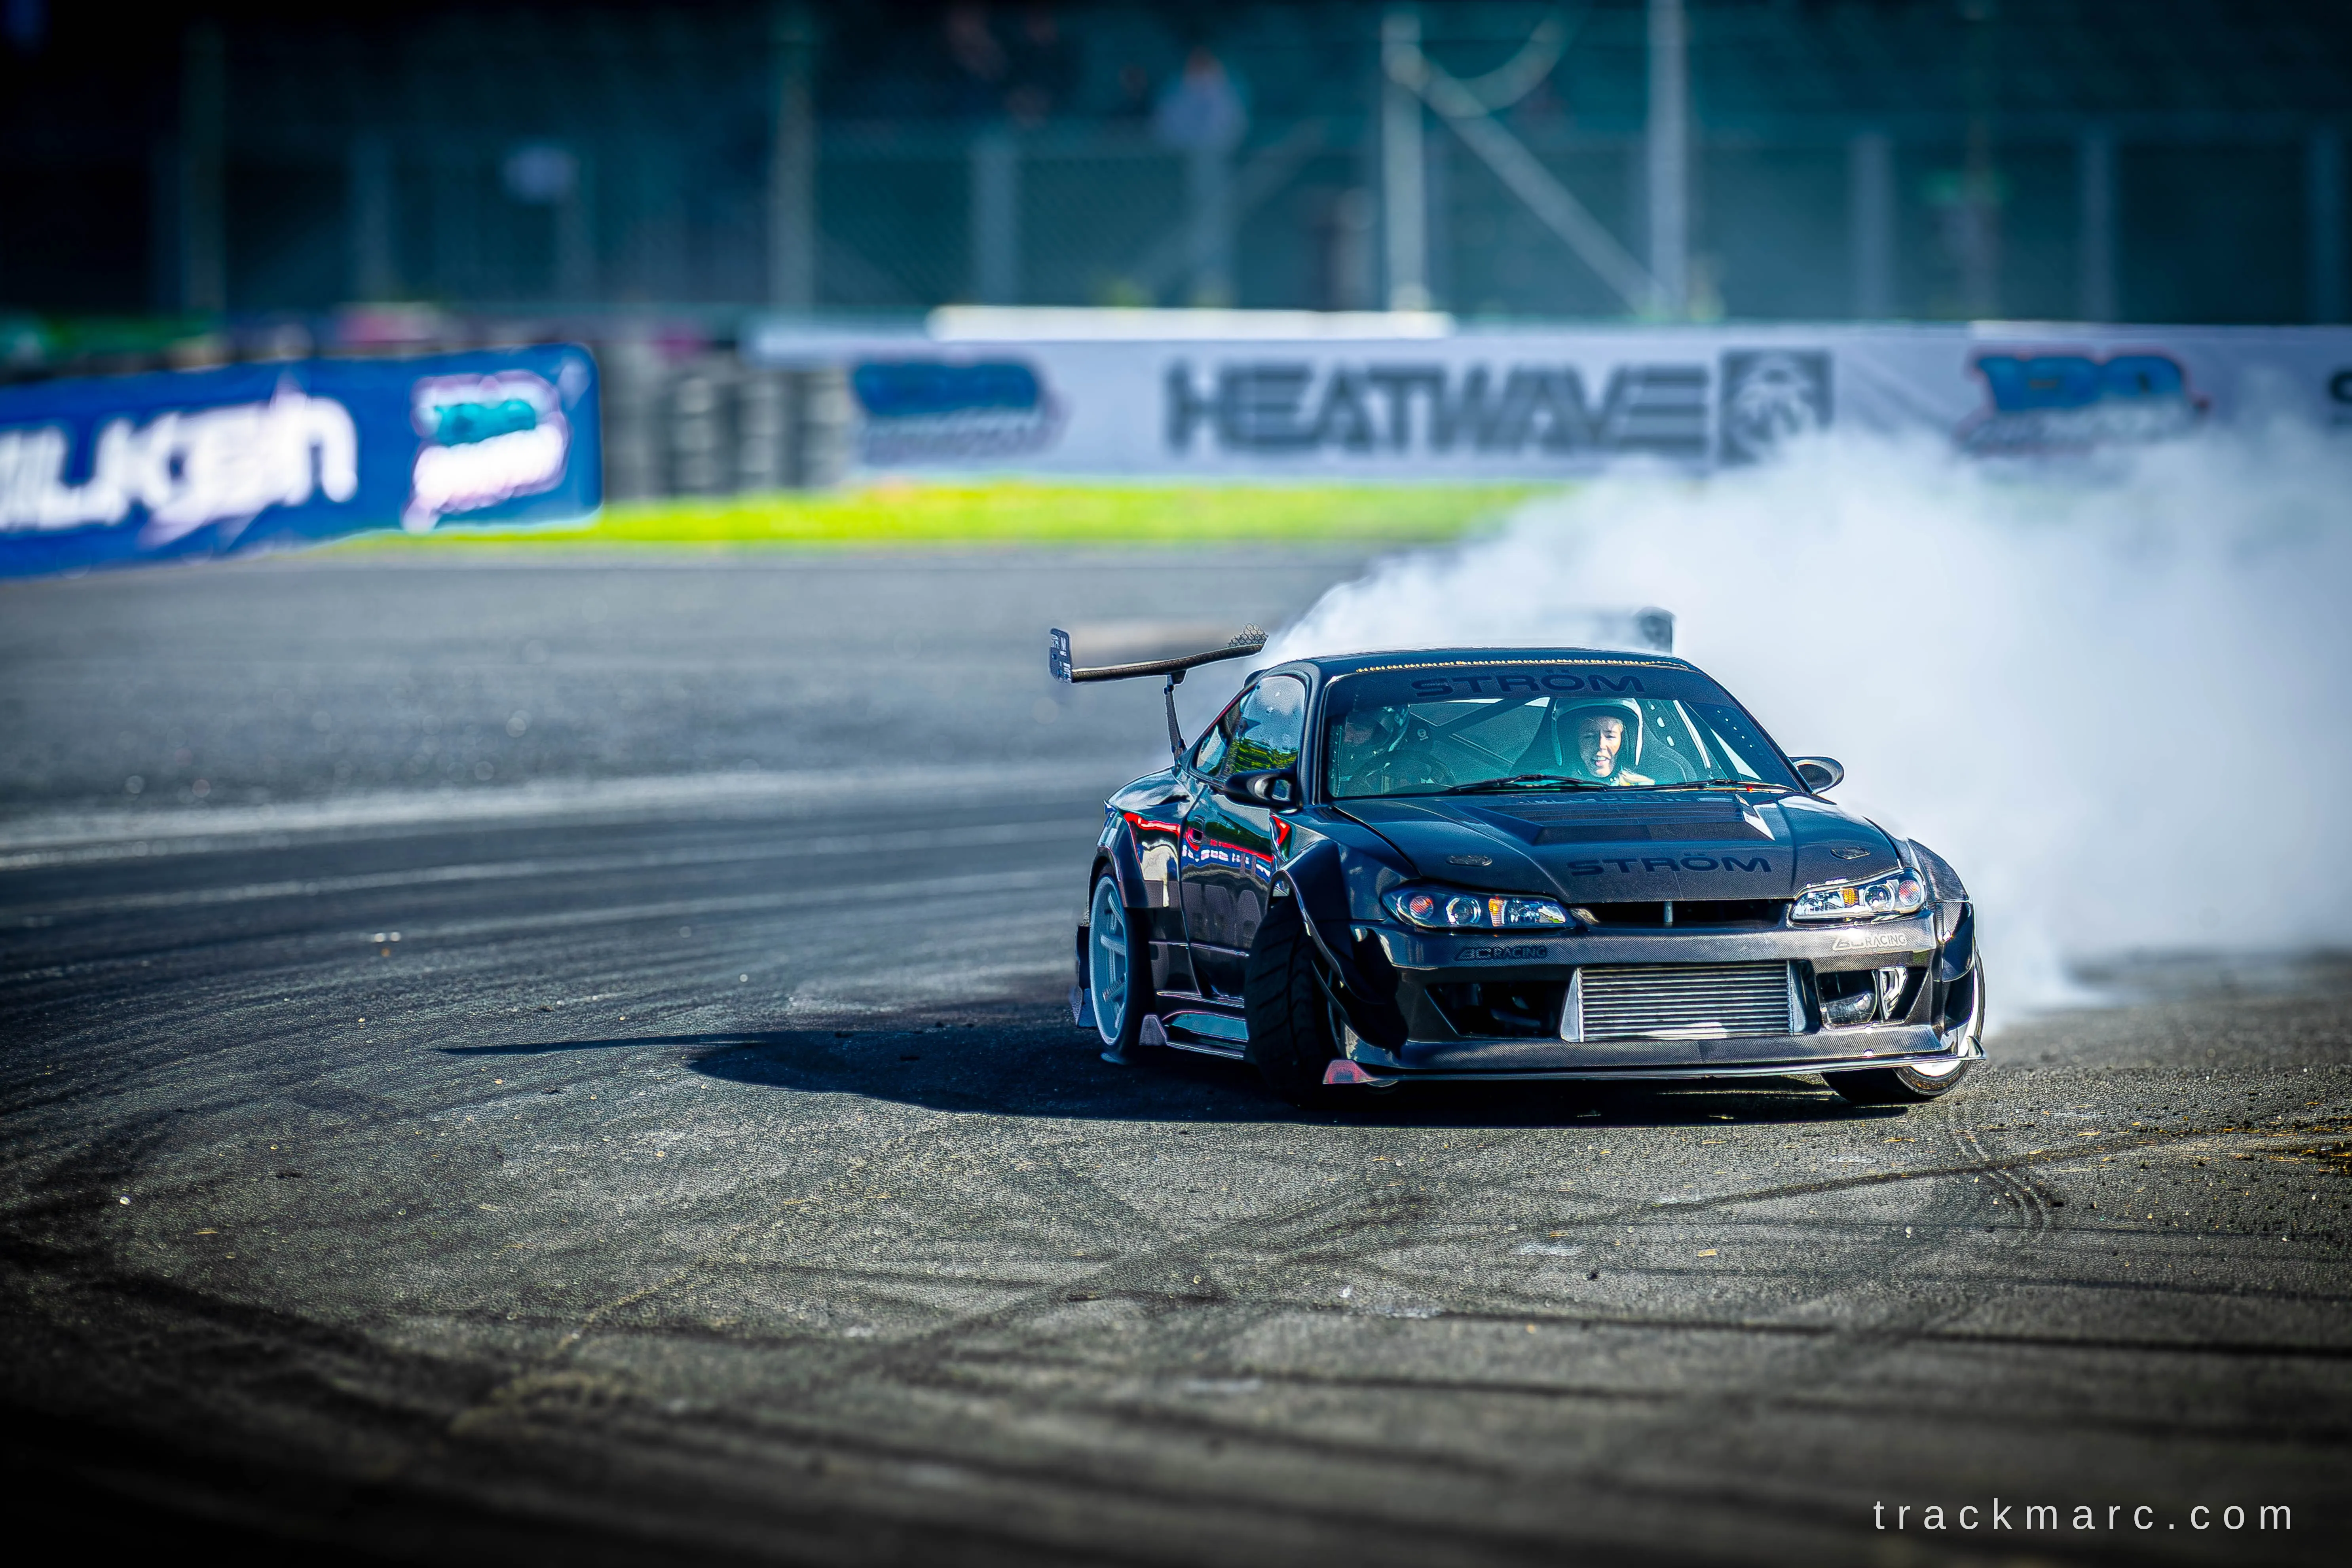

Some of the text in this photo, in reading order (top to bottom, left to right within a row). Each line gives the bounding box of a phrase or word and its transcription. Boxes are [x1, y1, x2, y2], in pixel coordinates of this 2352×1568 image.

[1166, 360, 1709, 454] HEATWAVE
[1411, 669, 1645, 697] STRÖM
[1567, 852, 1772, 876] STRÖM
[1865, 934, 1906, 946] RACING
[1493, 946, 1546, 959] RACING
